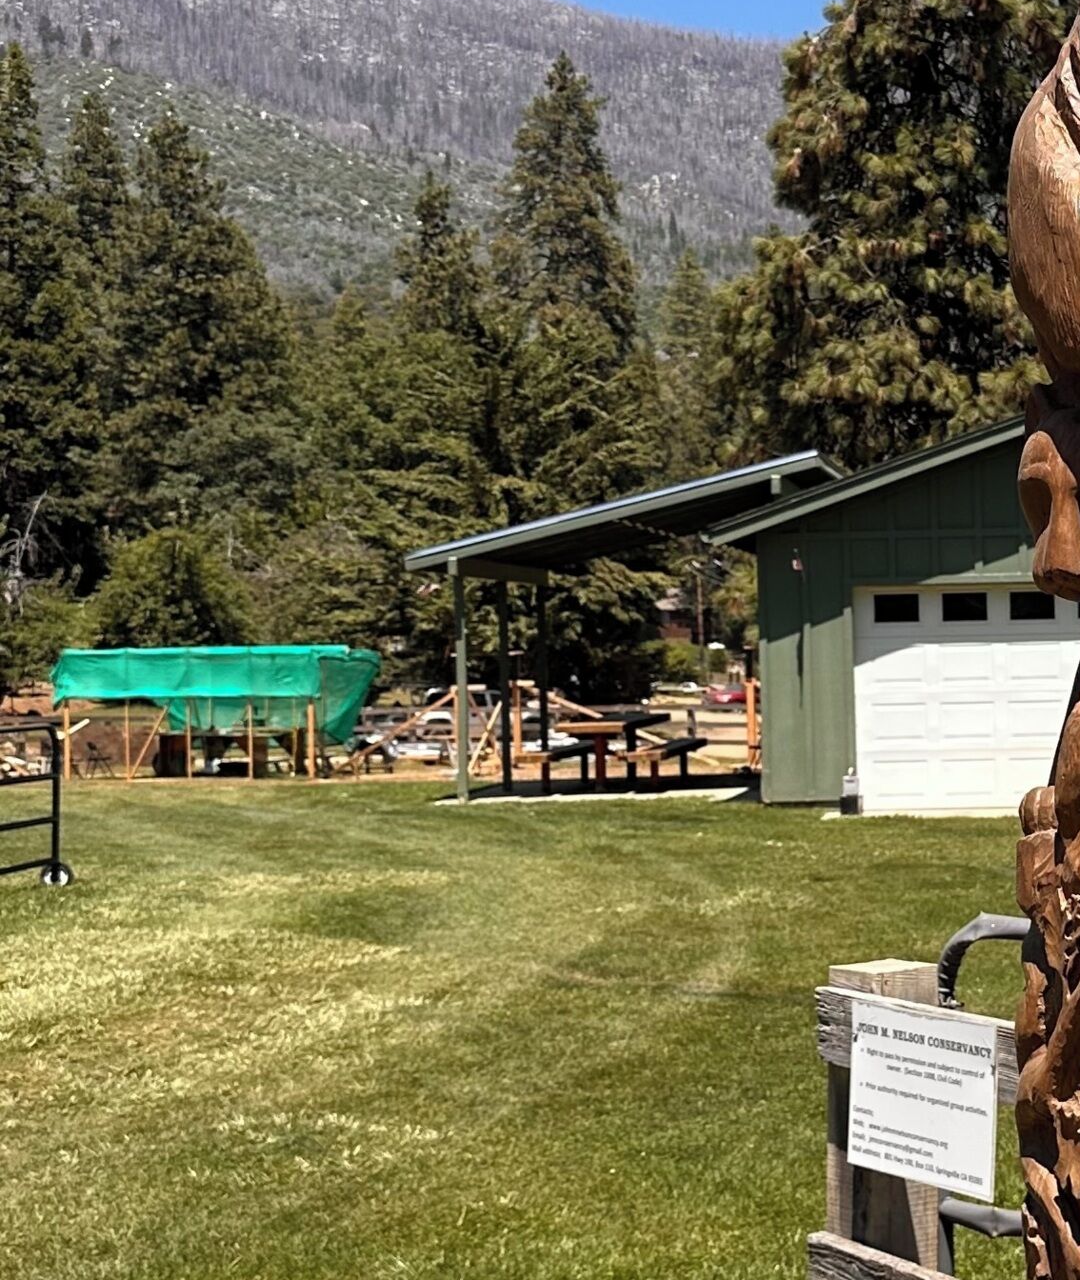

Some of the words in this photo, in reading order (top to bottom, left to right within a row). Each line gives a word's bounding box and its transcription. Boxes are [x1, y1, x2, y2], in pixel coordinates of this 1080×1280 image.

[856, 1021, 878, 1035] JOHN
[880, 1026, 889, 1037] M.
[892, 1029, 925, 1045] NELSON
[927, 1036, 991, 1058] CONSERVANCY
[926, 1060, 935, 1068] and
